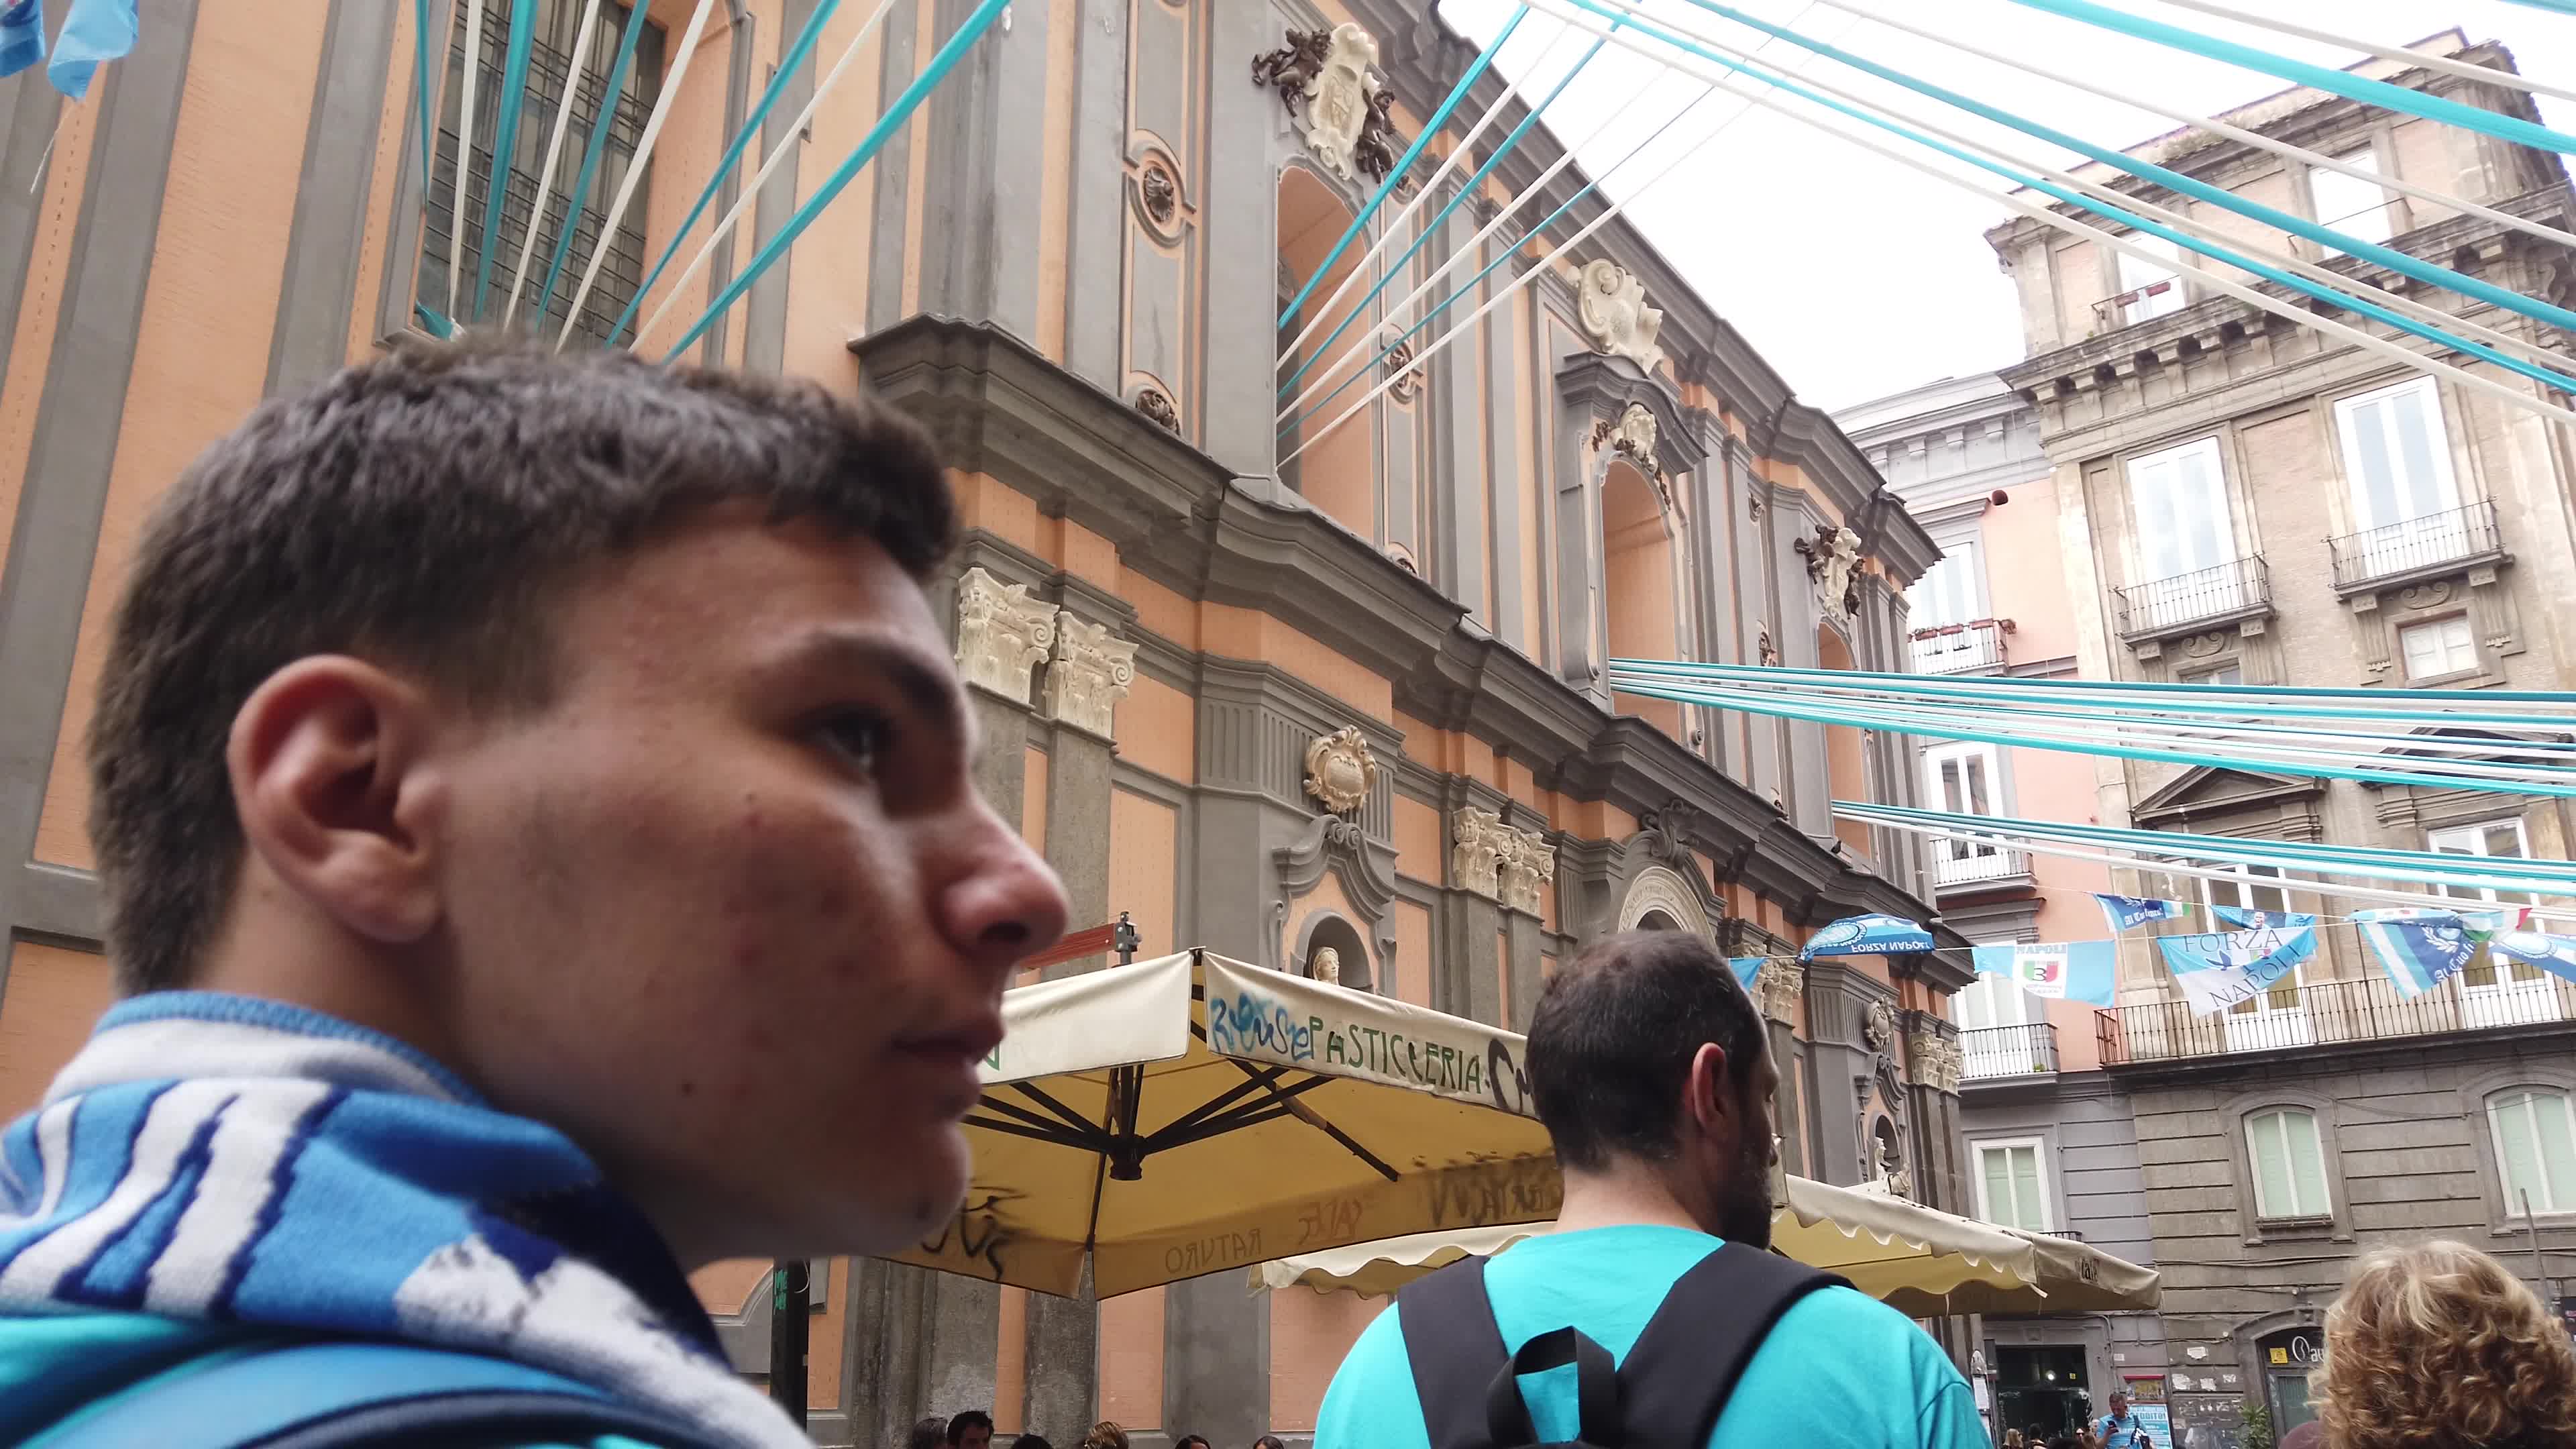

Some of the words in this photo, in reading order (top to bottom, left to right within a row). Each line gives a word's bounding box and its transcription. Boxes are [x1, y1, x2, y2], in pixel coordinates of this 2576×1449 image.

[2183, 930, 2283, 952] FORZA
[2031, 967, 2047, 981] 3
[2208, 944, 2300, 1008] NAPOLI
[1309, 1015, 1482, 1094] PASTICCERIA
